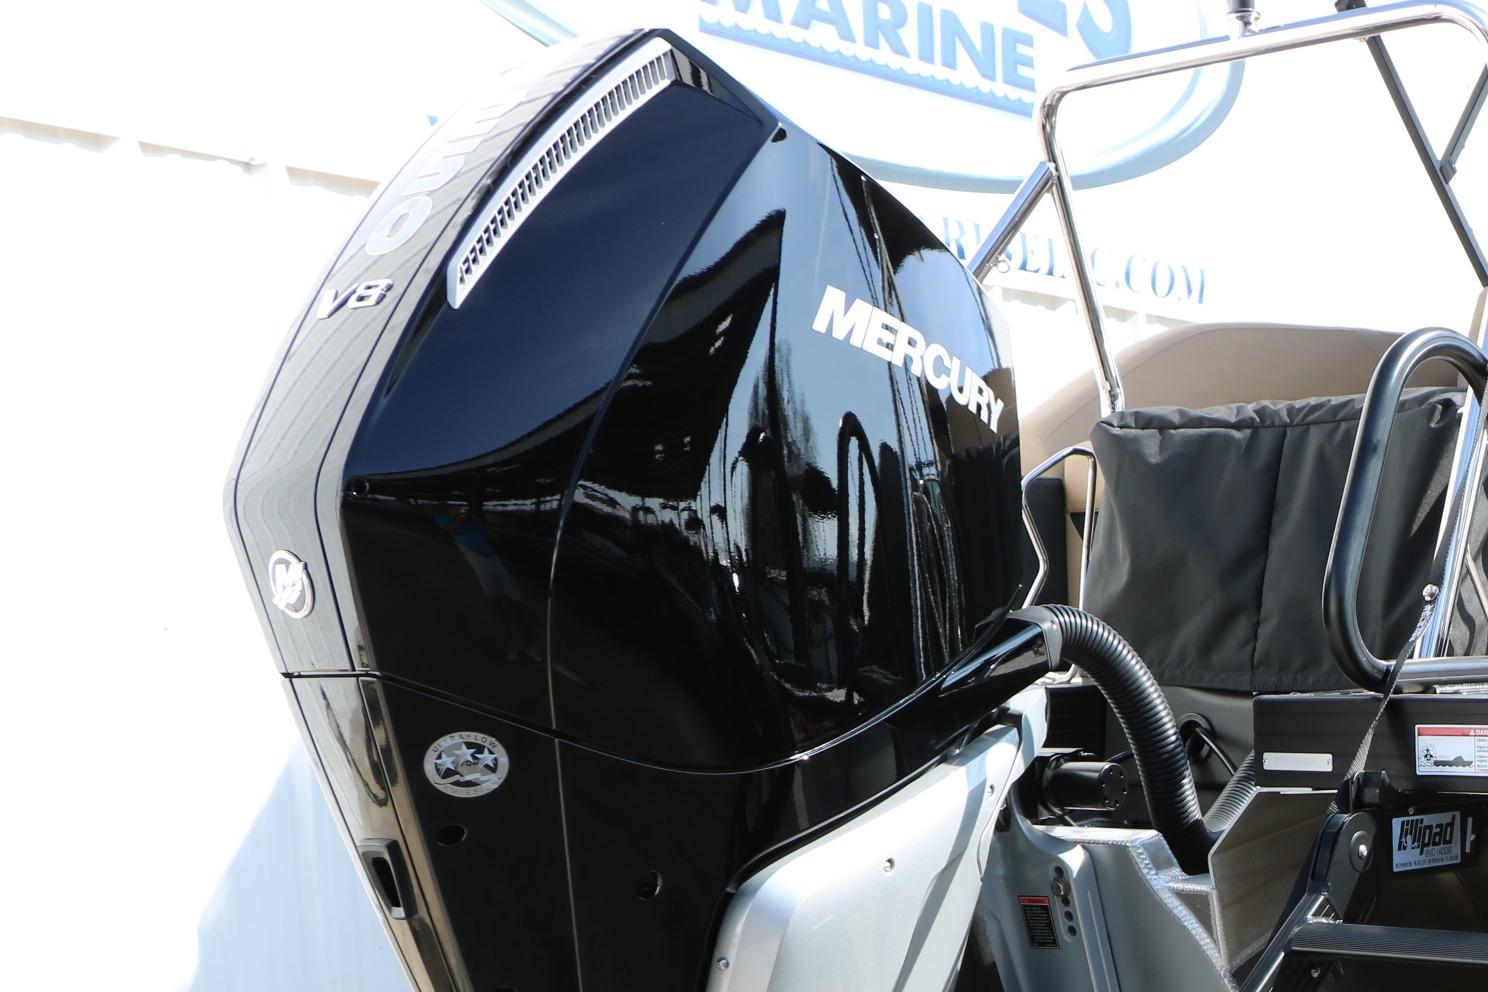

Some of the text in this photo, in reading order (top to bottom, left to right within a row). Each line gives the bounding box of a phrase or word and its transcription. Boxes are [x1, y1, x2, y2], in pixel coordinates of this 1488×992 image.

[701, 0, 1035, 91] ARINE
[316, 278, 394, 320] V8
[811, 285, 1004, 434] MERCURY
[474, 735, 498, 749] LOW
